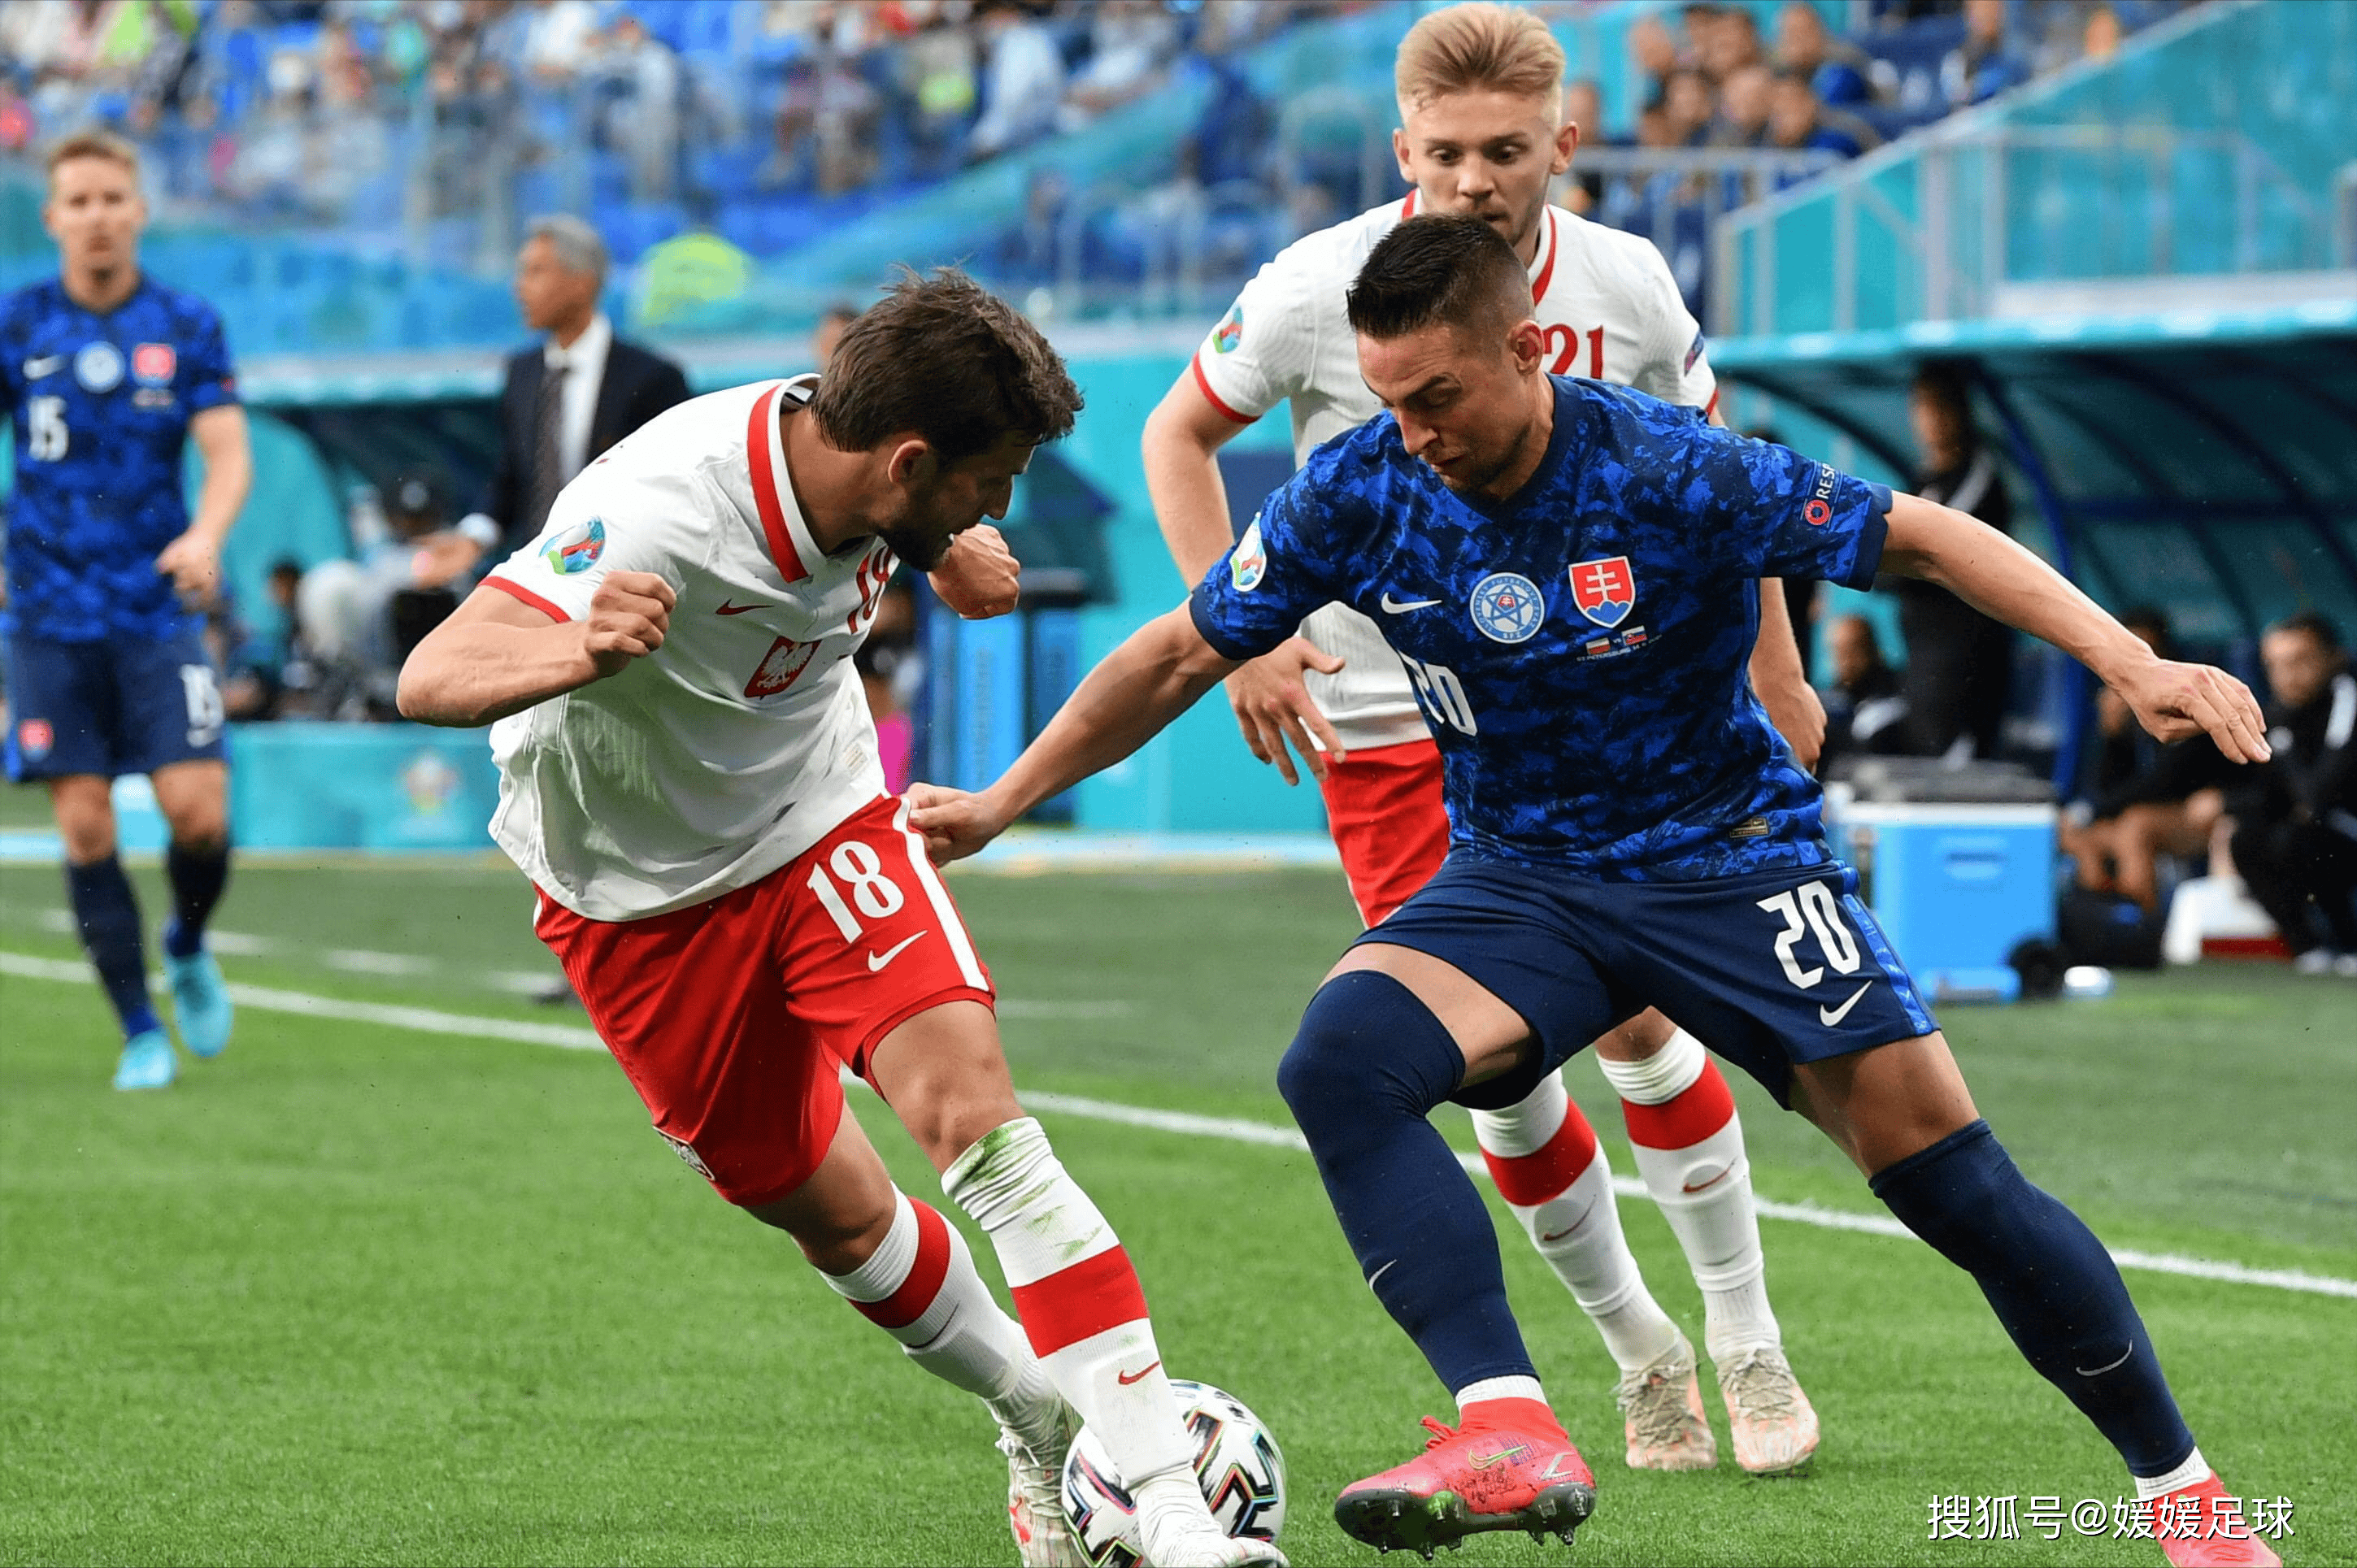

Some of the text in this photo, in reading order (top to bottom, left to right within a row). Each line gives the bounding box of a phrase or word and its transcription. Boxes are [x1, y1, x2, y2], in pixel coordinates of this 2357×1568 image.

[1542, 324, 1604, 380] 21
[1398, 649, 1478, 737] 20
[806, 840, 905, 945] 18
[1755, 880, 1861, 990] 20
